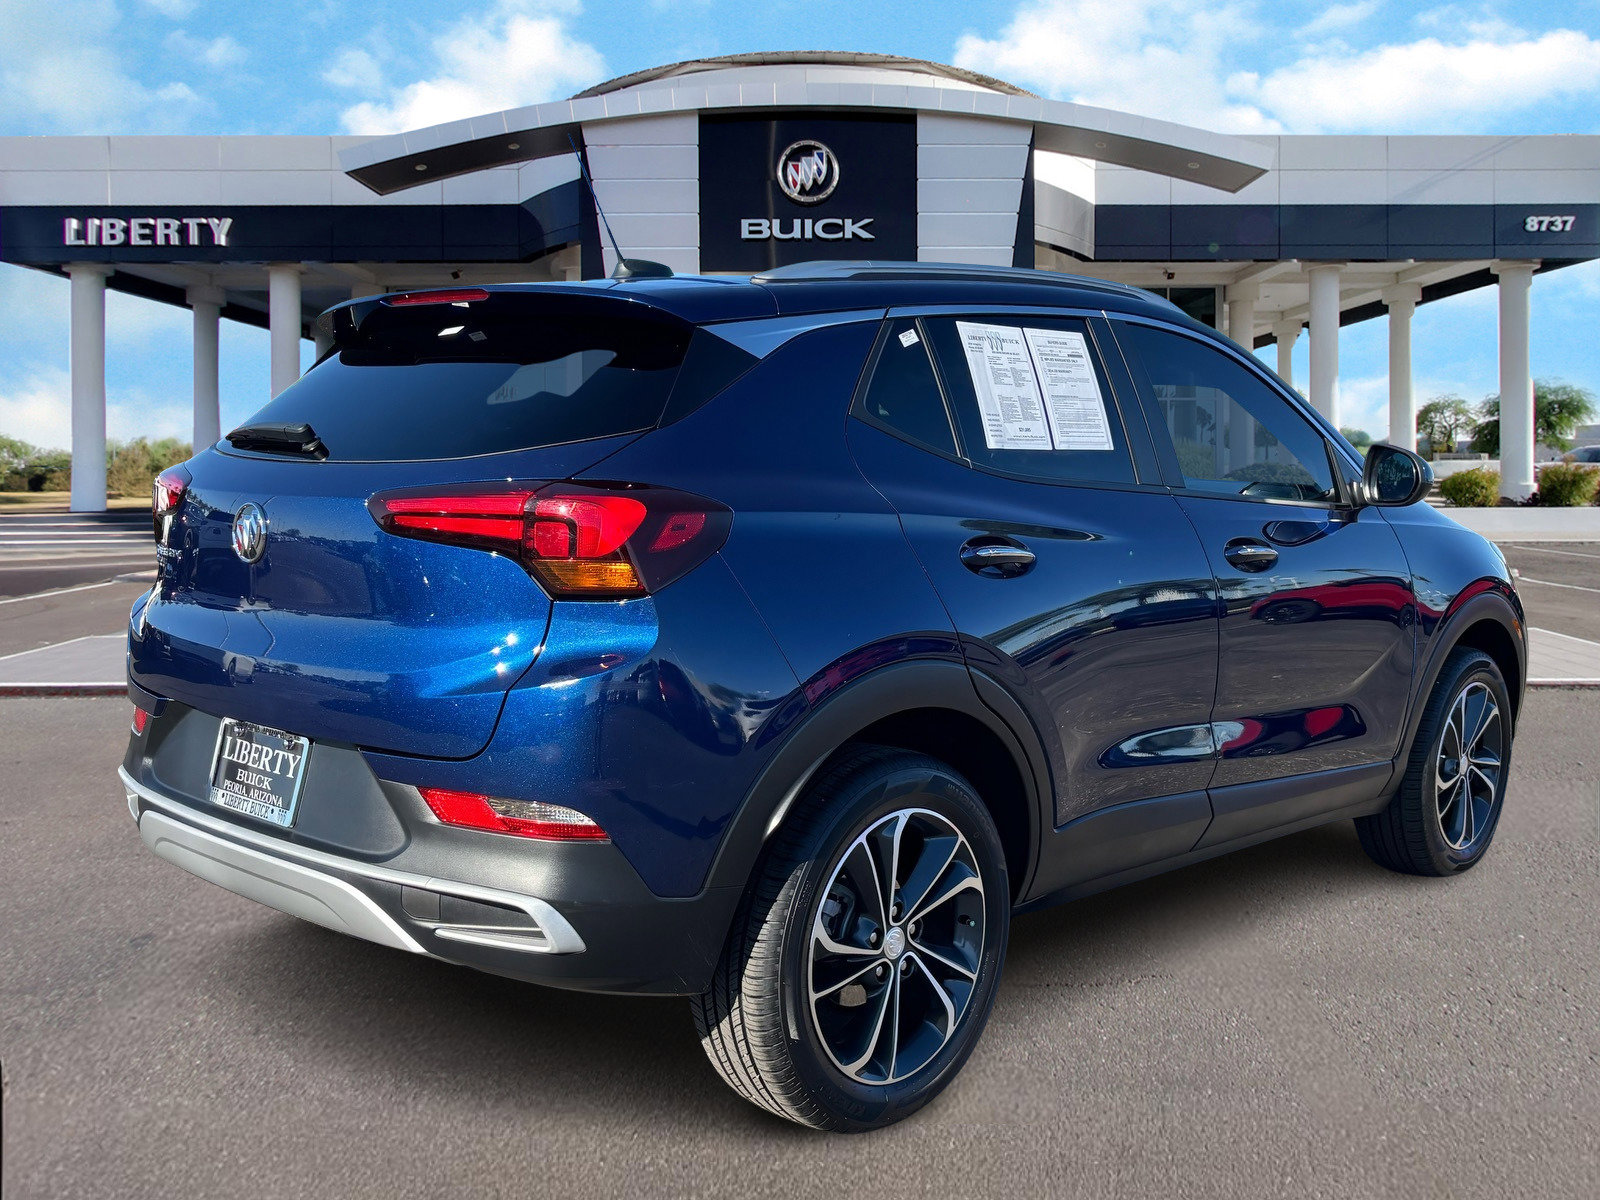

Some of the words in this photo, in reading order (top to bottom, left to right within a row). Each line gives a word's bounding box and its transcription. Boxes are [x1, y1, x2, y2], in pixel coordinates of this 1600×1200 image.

[64, 217, 233, 247] LIBERTY
[741, 218, 875, 239] BUICK
[1524, 215, 1576, 232] 8737
[1002, 337, 1020, 345] BUICK
[223, 736, 301, 778] LIBERTY
[236, 768, 273, 790] BUICK
[223, 792, 251, 812] LIBERTY
[250, 801, 270, 818] BUICK
[248, 788, 283, 807] ARIZONA
